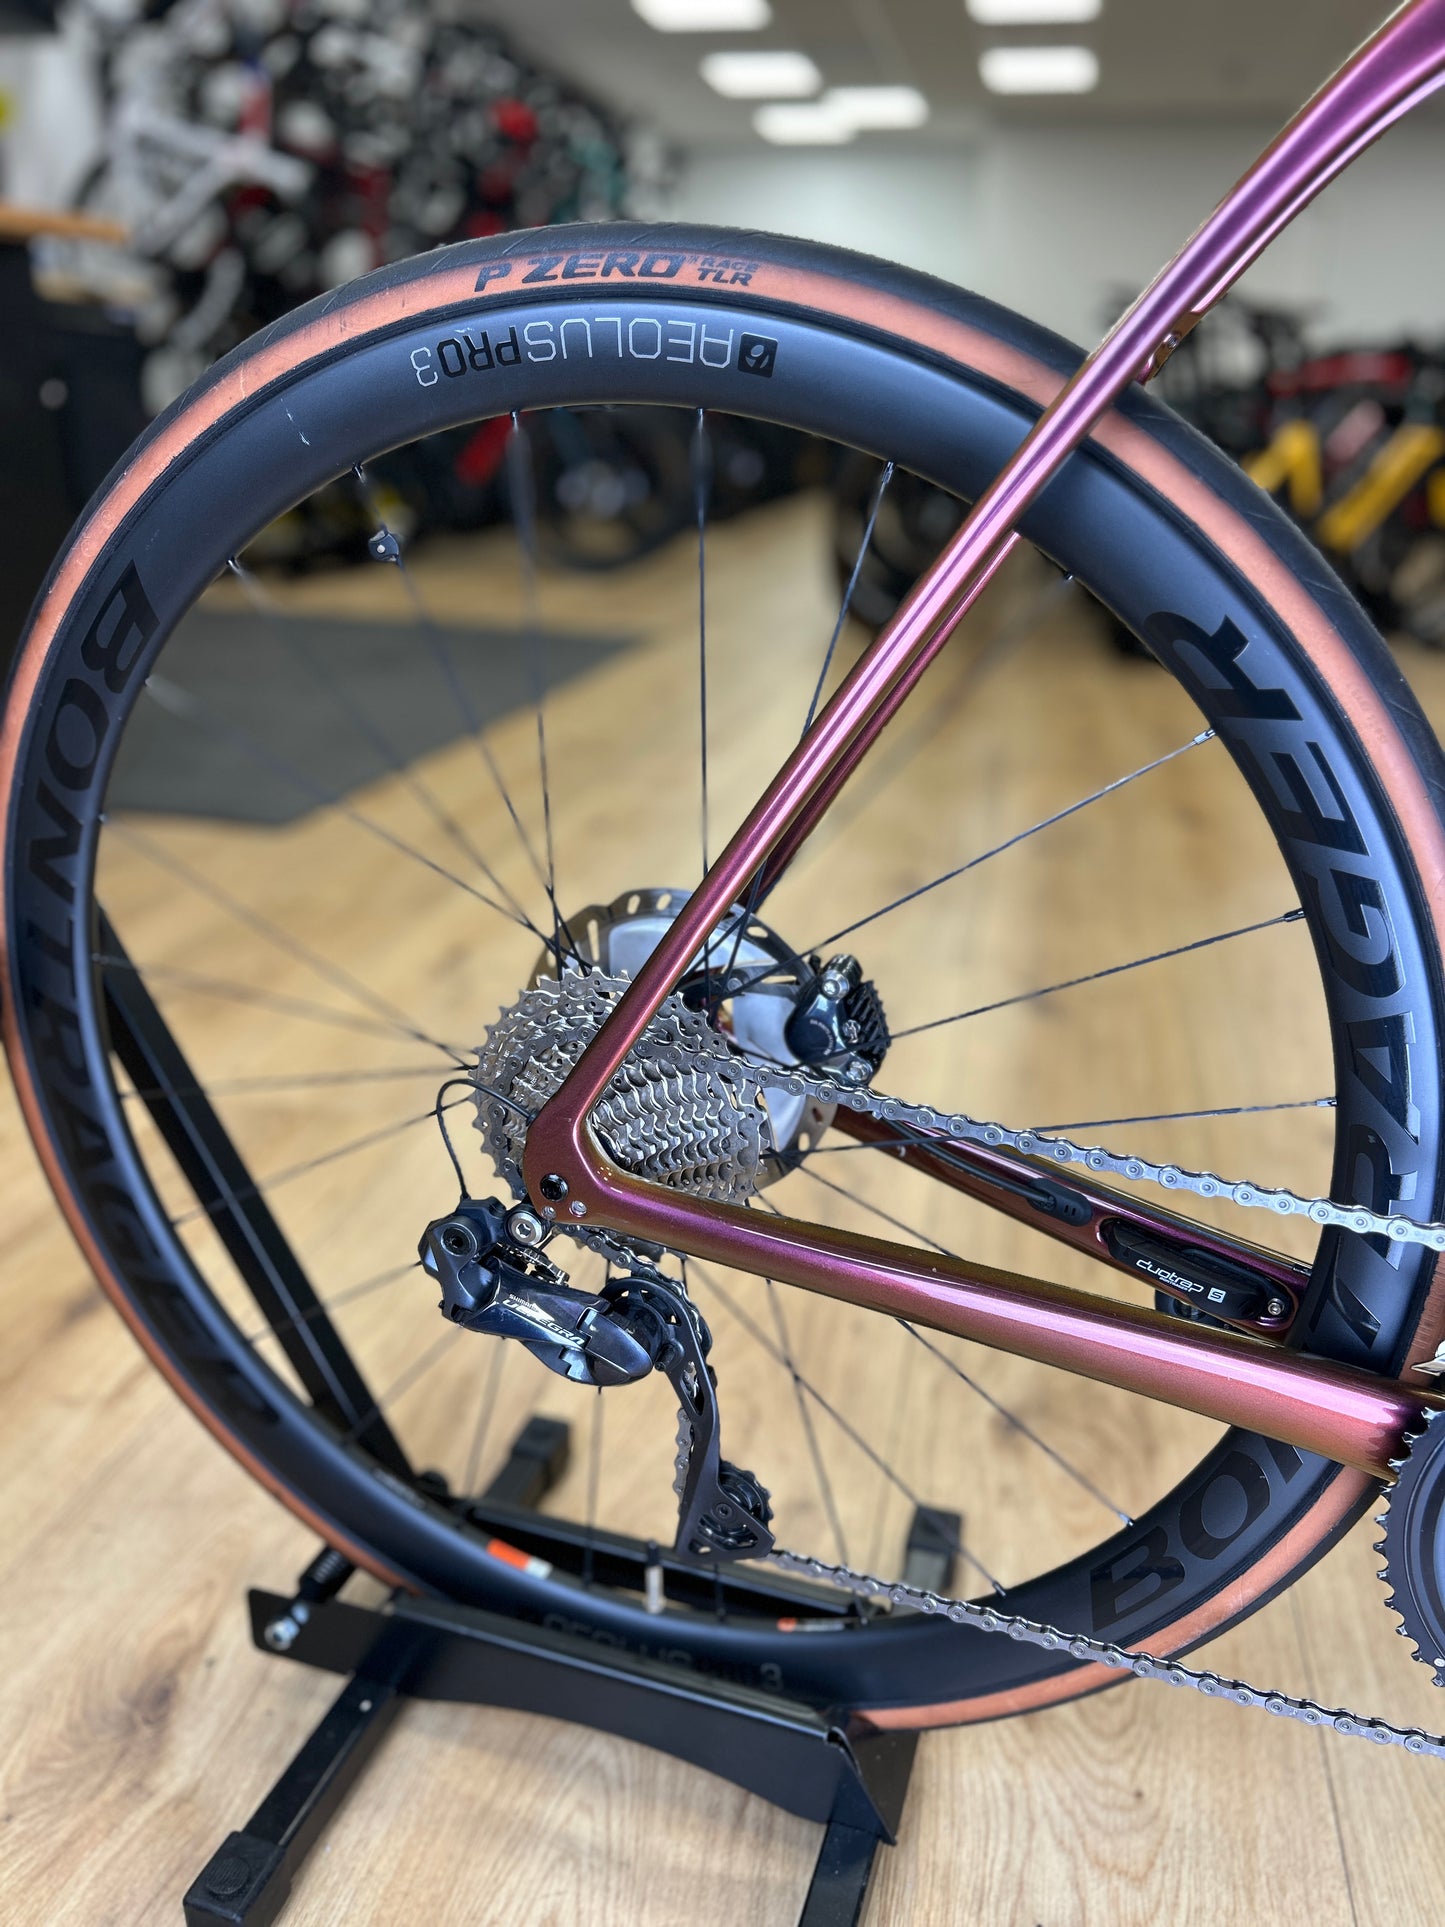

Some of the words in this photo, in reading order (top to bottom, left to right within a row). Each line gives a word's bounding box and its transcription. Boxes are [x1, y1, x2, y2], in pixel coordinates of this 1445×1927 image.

[474, 263, 512, 292] P
[522, 252, 686, 285] ZERO
[697, 267, 753, 286] TLR
[700, 256, 760, 273] RACE
[523, 317, 734, 369] AEOLUS
[1090, 611, 1421, 1632] BOTRAGER
[1136, 1259, 1204, 1292] duotrap
